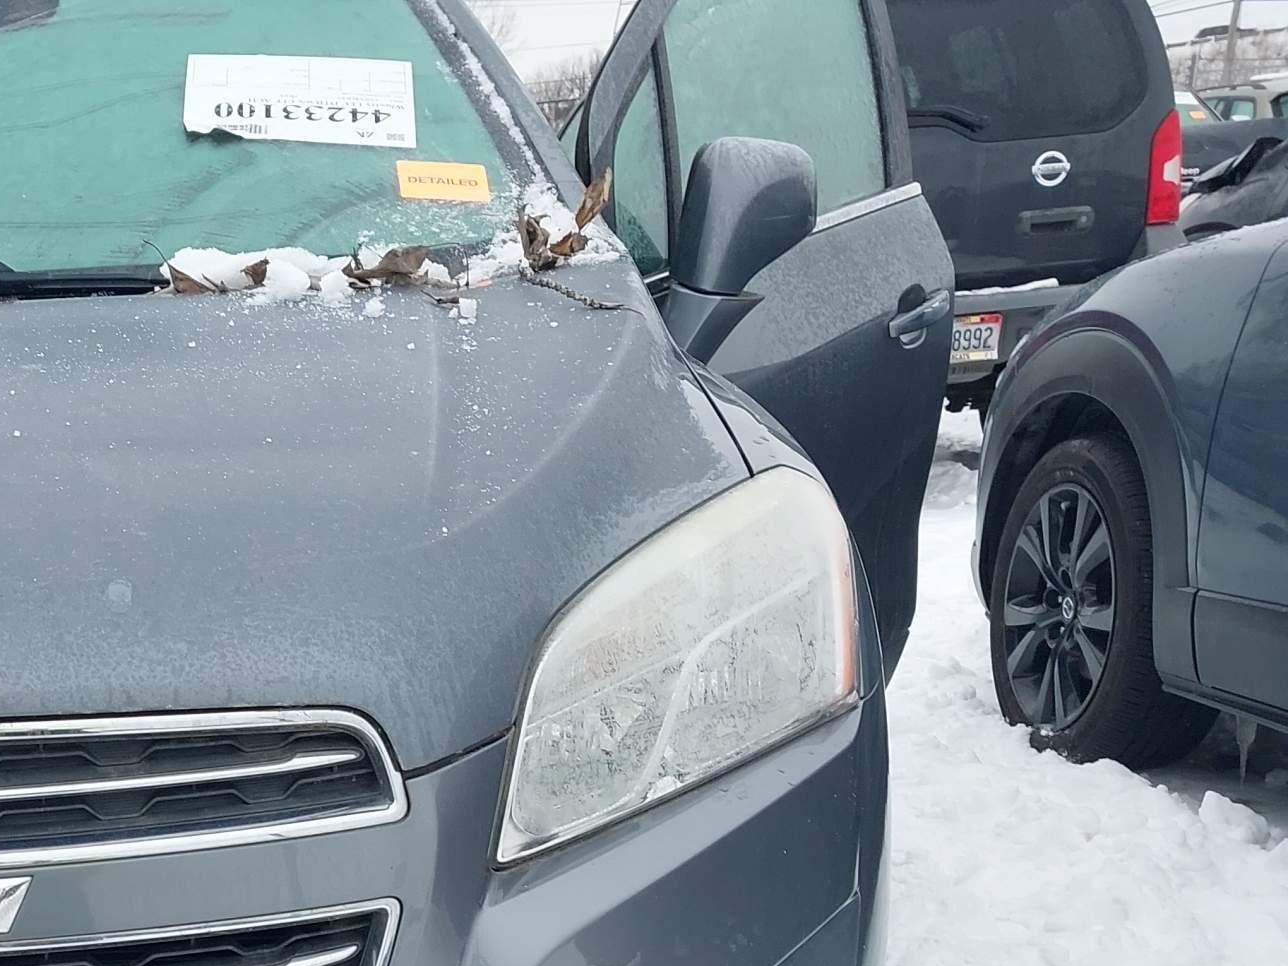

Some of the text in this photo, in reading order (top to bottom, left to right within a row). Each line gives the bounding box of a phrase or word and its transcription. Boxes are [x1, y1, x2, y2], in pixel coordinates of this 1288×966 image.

[214, 102, 391, 124] 44233100
[407, 175, 479, 188] DETAILED
[952, 327, 993, 352] 8992
